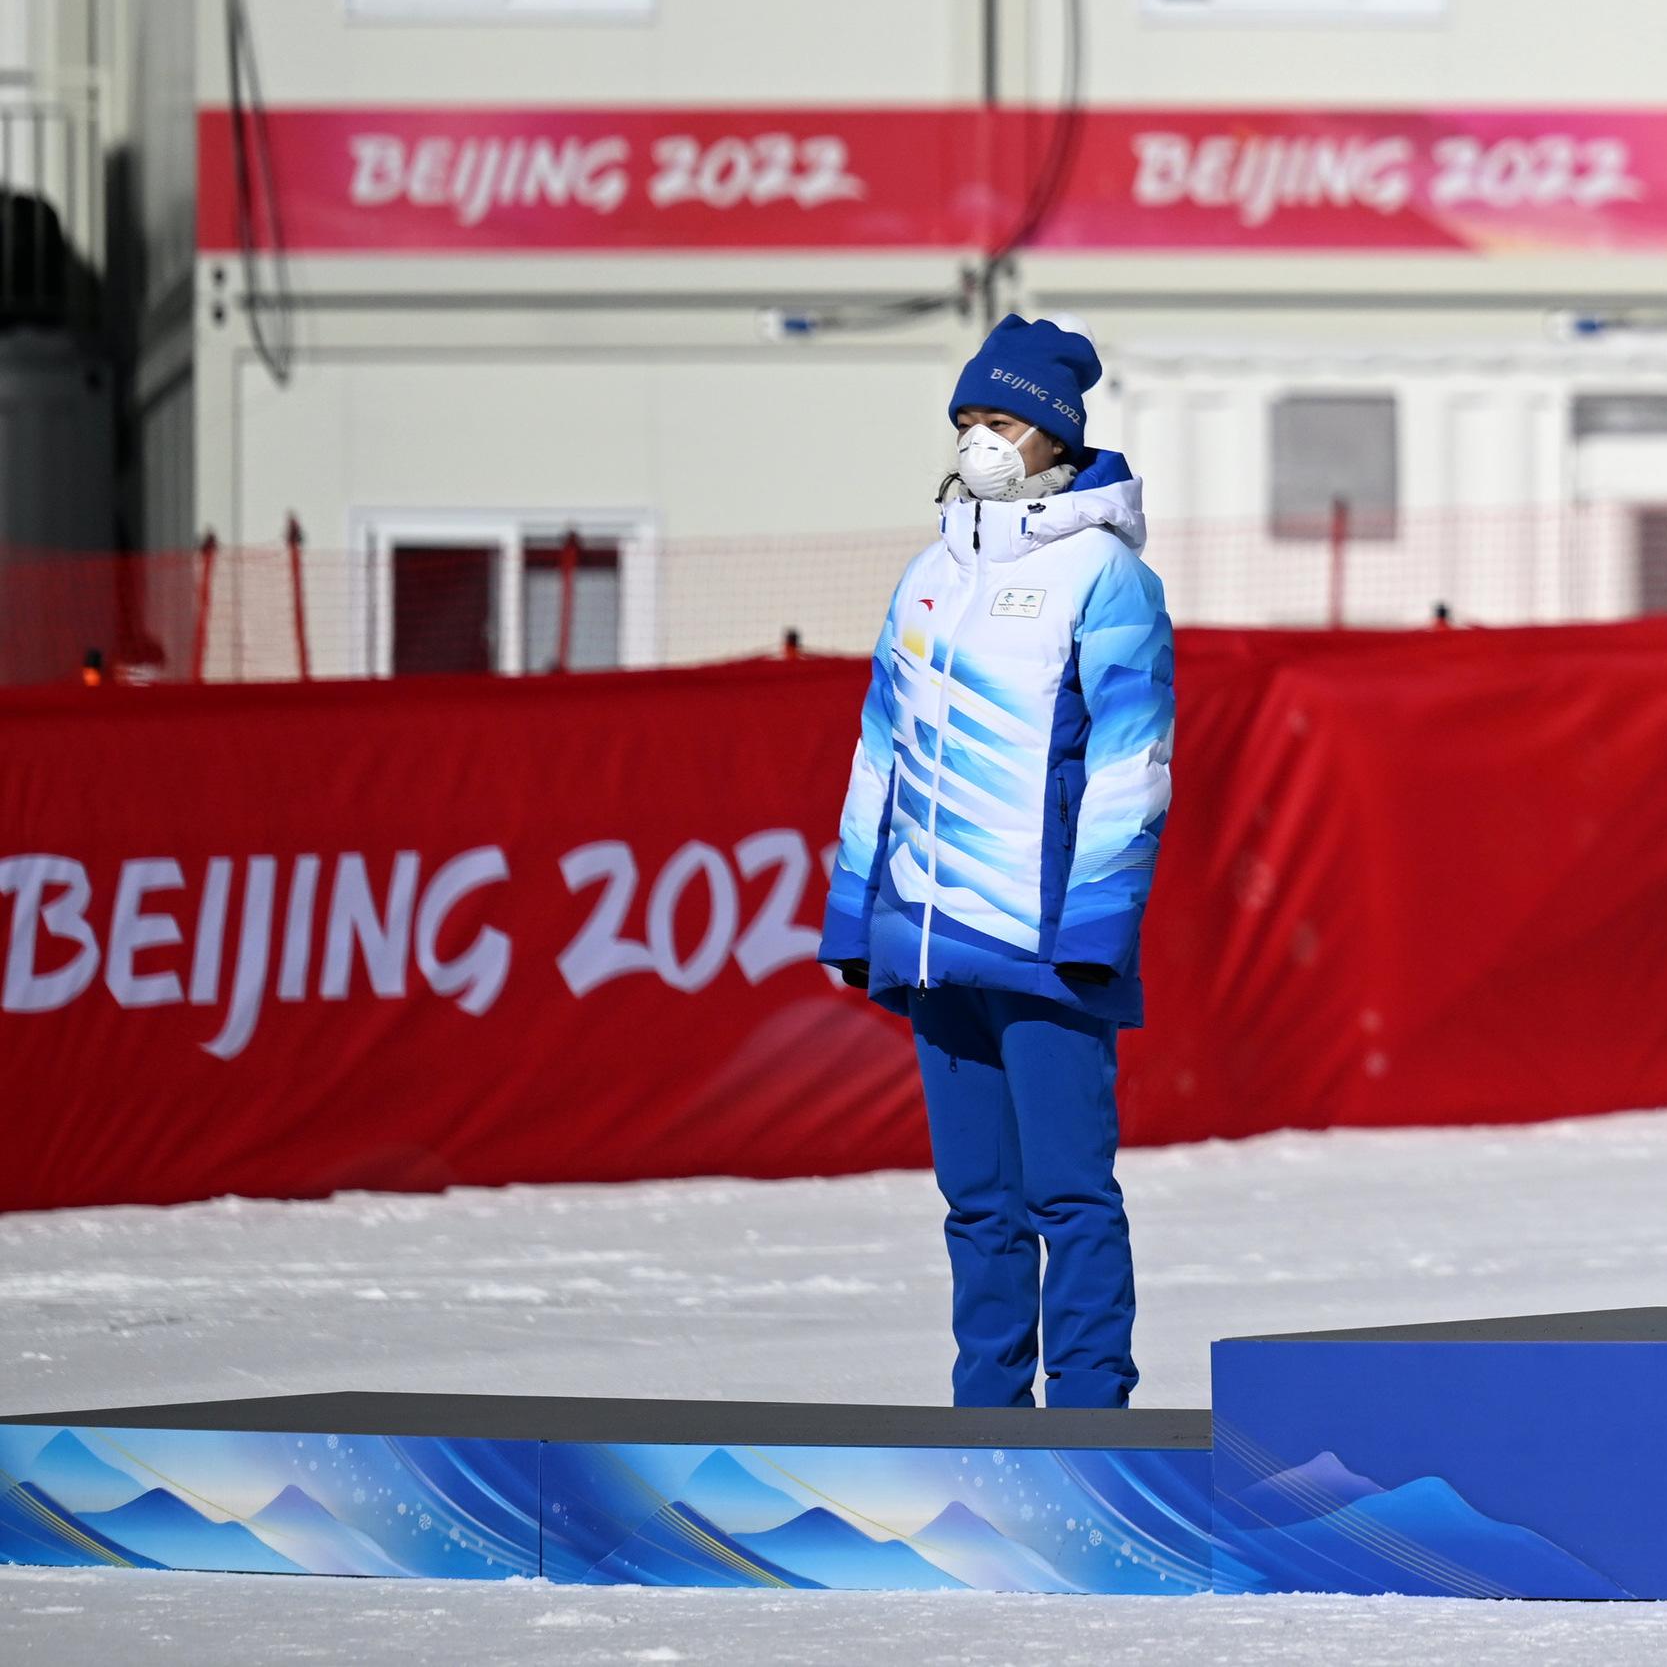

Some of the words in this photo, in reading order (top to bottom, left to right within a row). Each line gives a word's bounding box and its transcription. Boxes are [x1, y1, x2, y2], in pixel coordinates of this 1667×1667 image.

[350, 134, 628, 224] BEIJING
[648, 133, 864, 207] 2022
[1131, 131, 1412, 227] BEIJING
[1430, 135, 1641, 205] 2022
[990, 368, 1049, 401] BEIJING
[1052, 398, 1081, 425] 2022
[0, 844, 511, 1060] BEIJING
[556, 827, 848, 999] 202
